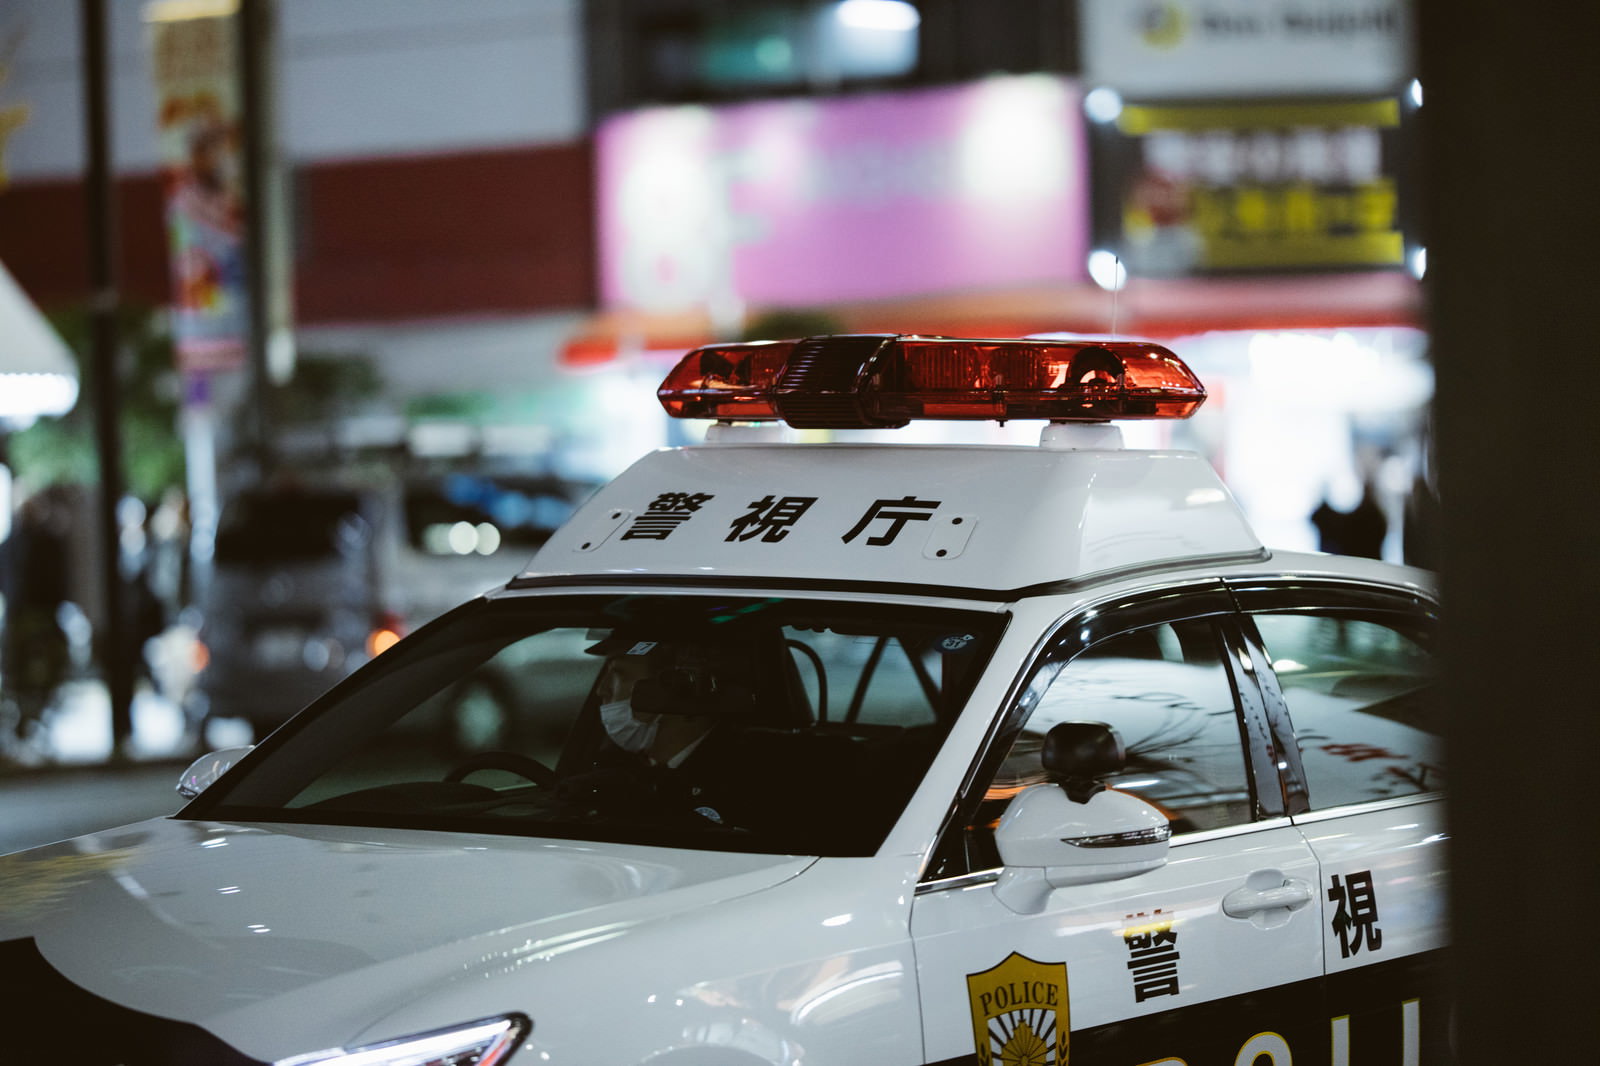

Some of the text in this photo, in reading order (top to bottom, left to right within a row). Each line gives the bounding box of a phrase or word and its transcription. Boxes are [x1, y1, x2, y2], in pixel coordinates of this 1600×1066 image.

[620, 492, 942, 547] 警視庁
[1328, 870, 1382, 959] 視
[979, 980, 1059, 1017] POLICE
